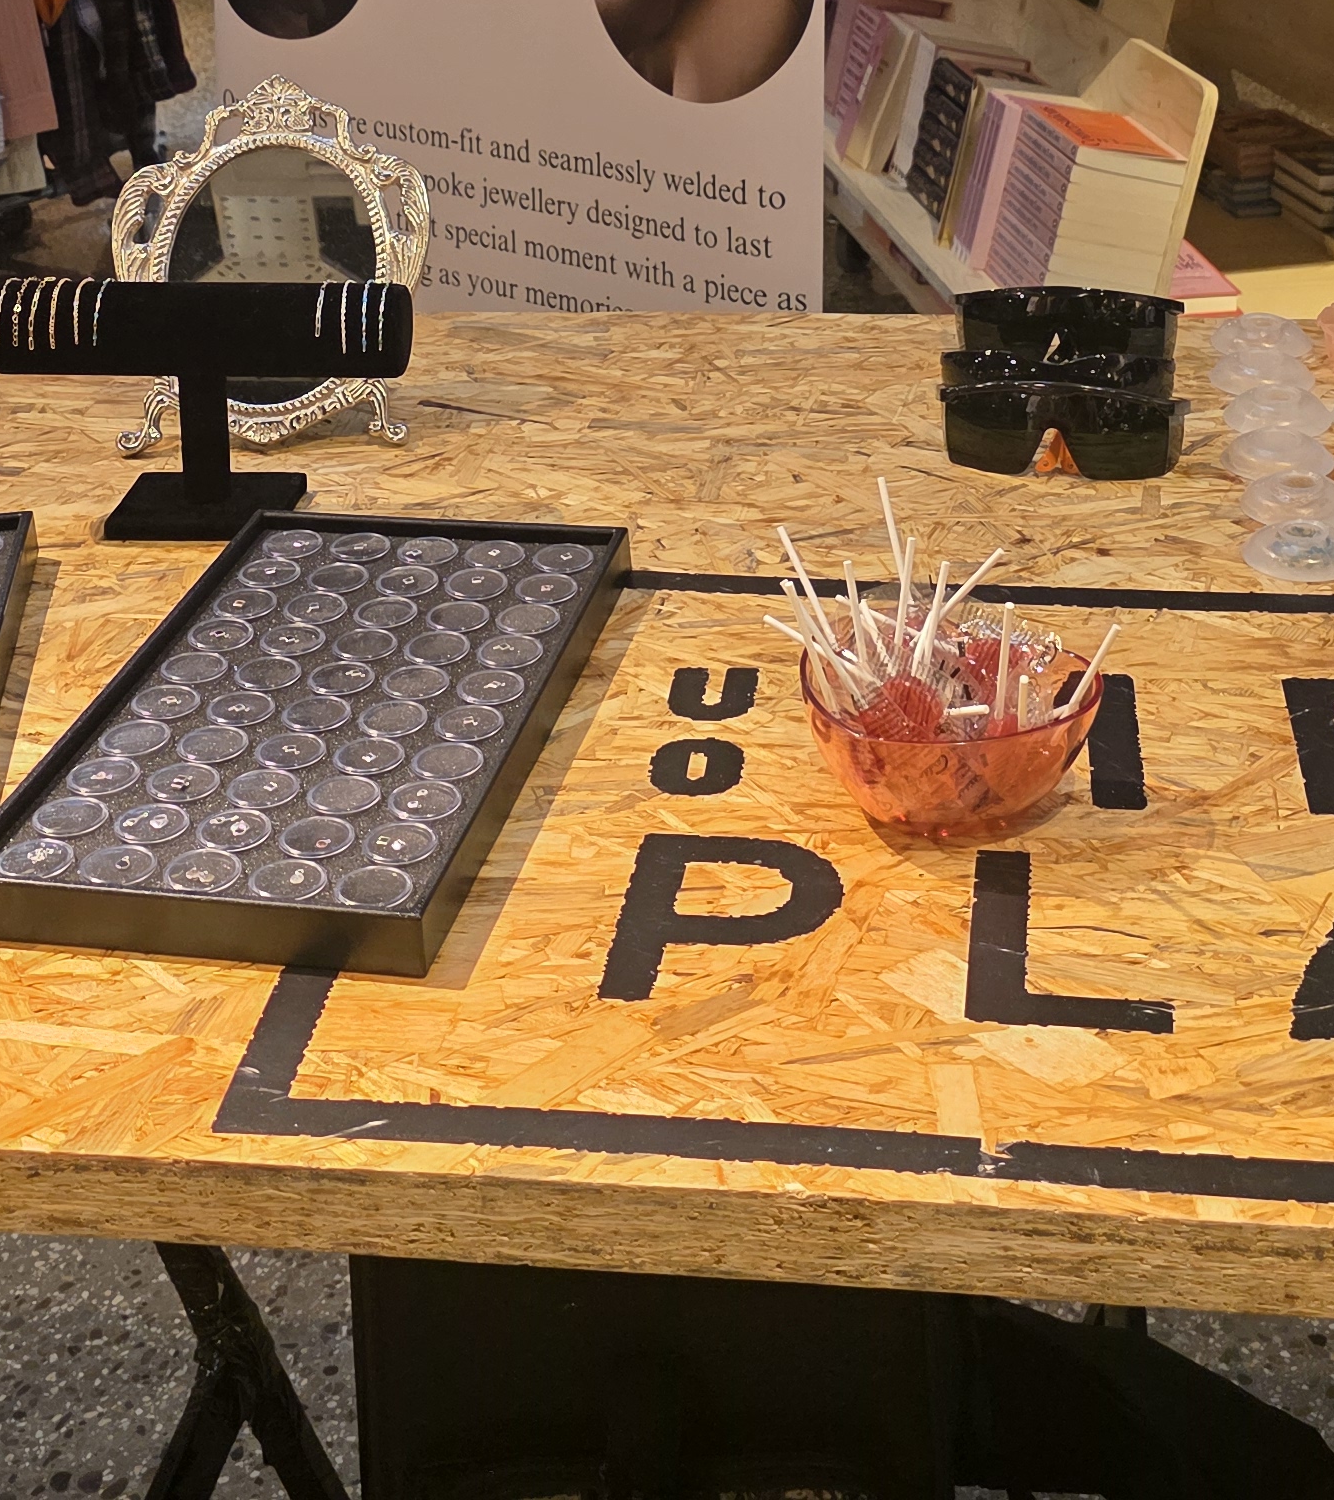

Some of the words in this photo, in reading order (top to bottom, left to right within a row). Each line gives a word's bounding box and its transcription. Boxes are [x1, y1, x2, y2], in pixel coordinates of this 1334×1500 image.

[373, 119, 483, 156] custom-fit
[490, 140, 531, 165] and
[538, 147, 656, 192] seamlessly
[663, 166, 748, 206] welded
[757, 184, 786, 211] to
[480, 177, 578, 225] jewellery
[586, 198, 685, 244] designed
[694, 223, 718, 249] to
[727, 227, 772, 260] last
[438, 267, 461, 287] as
[467, 272, 518, 300] your
[525, 286, 633, 312] memori
[444, 222, 517, 255] special
[524, 241, 617, 275] moment
[624, 256, 675, 289] with
[683, 274, 696, 294] a
[703, 279, 768, 309] piece
[777, 290, 807, 312] as
